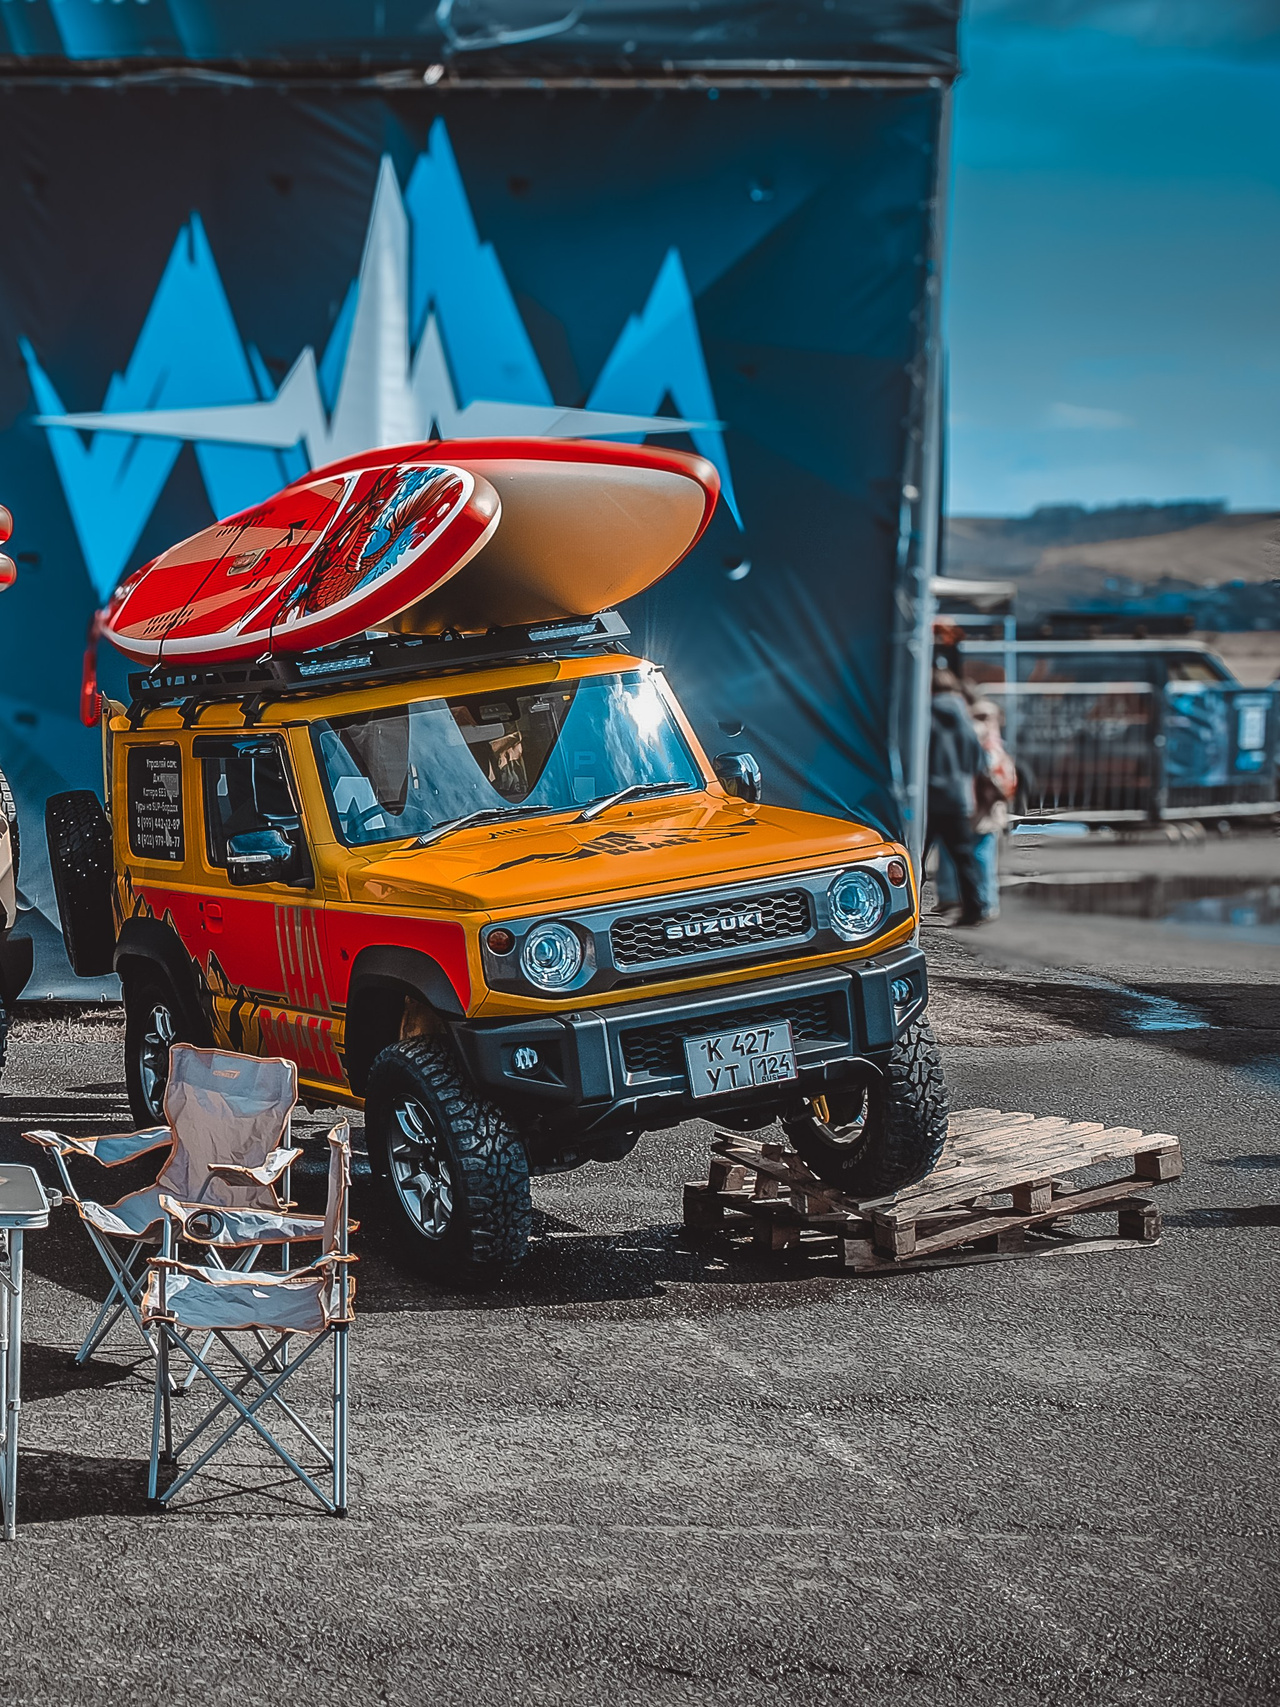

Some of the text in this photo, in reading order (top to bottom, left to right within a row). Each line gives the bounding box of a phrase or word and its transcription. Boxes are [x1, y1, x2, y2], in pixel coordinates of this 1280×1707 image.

[666, 911, 763, 939] SUZUKI
[732, 1028, 770, 1056] 427
[757, 1054, 790, 1075] 124
[761, 1075, 777, 1083] RUS
